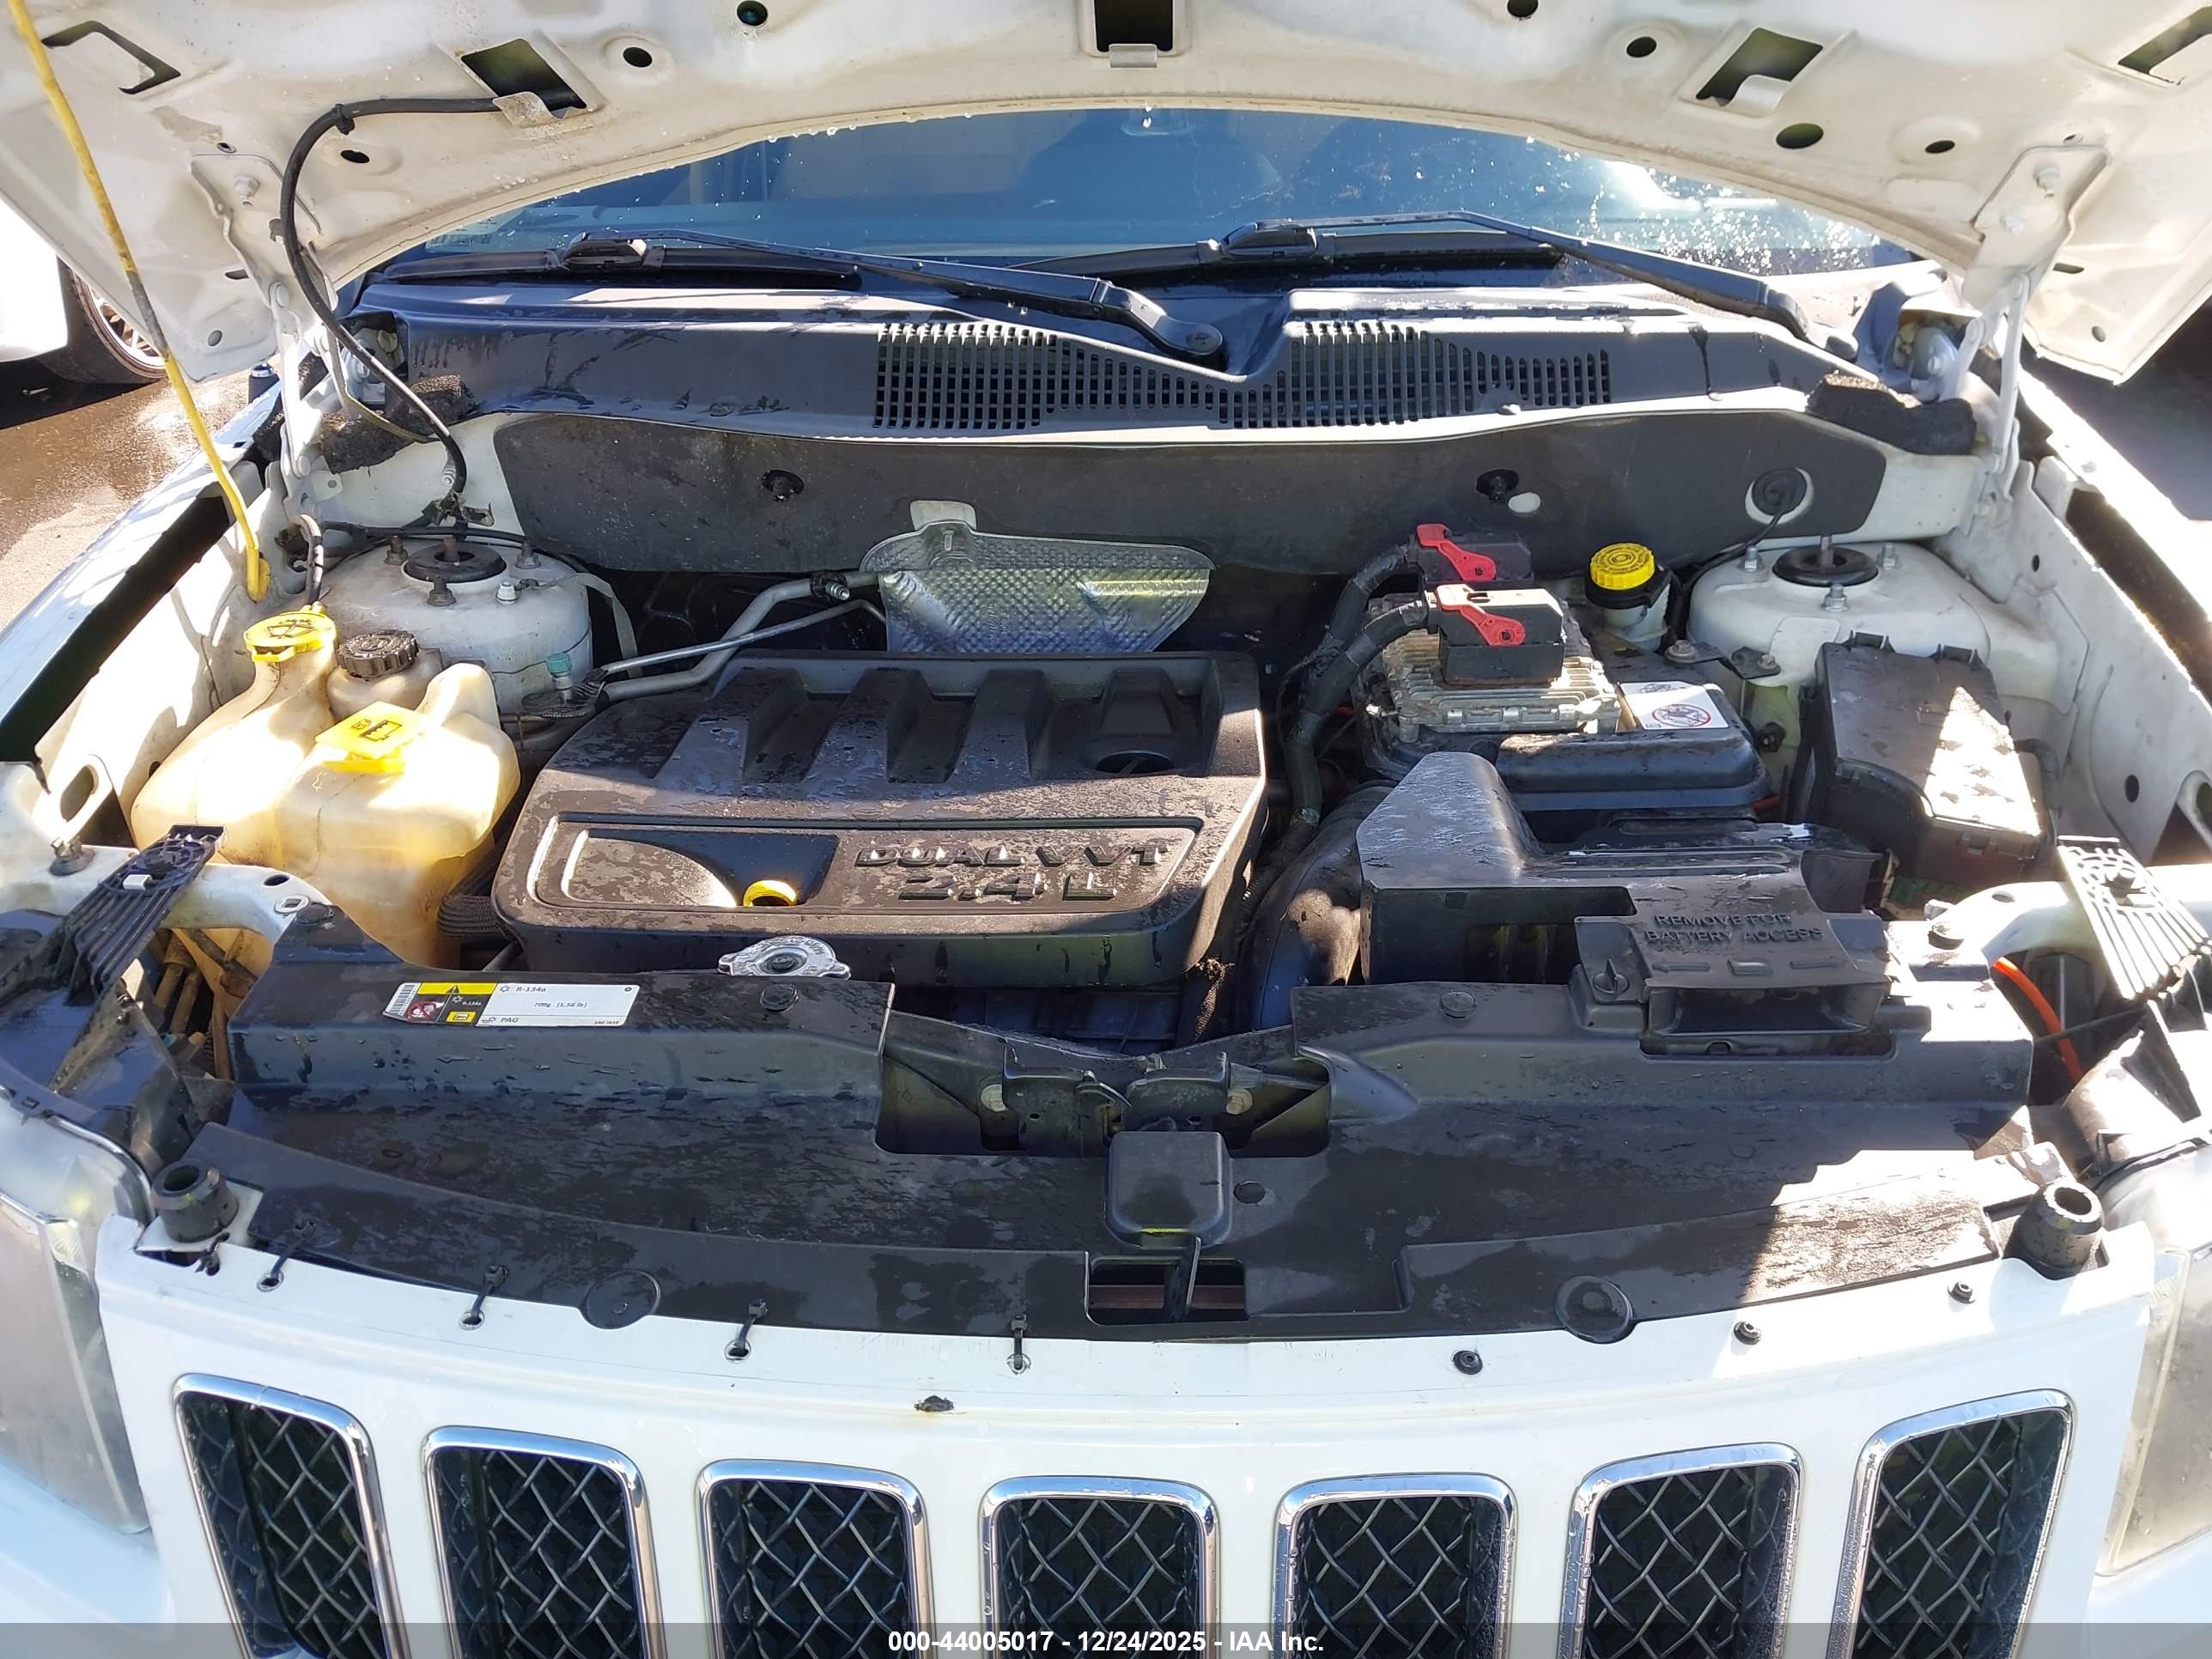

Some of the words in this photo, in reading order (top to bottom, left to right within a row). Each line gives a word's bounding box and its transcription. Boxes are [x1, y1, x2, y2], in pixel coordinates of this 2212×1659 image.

[855, 846, 1024, 866] DUAL
[1035, 844, 1170, 866] VVT
[898, 872, 1117, 900] 2.4L
[1654, 914, 1741, 929] REMOVE
[1744, 913, 1791, 927] FOR
[1644, 930, 1732, 944] BATTERY
[1743, 928, 1824, 943] ACCESS
